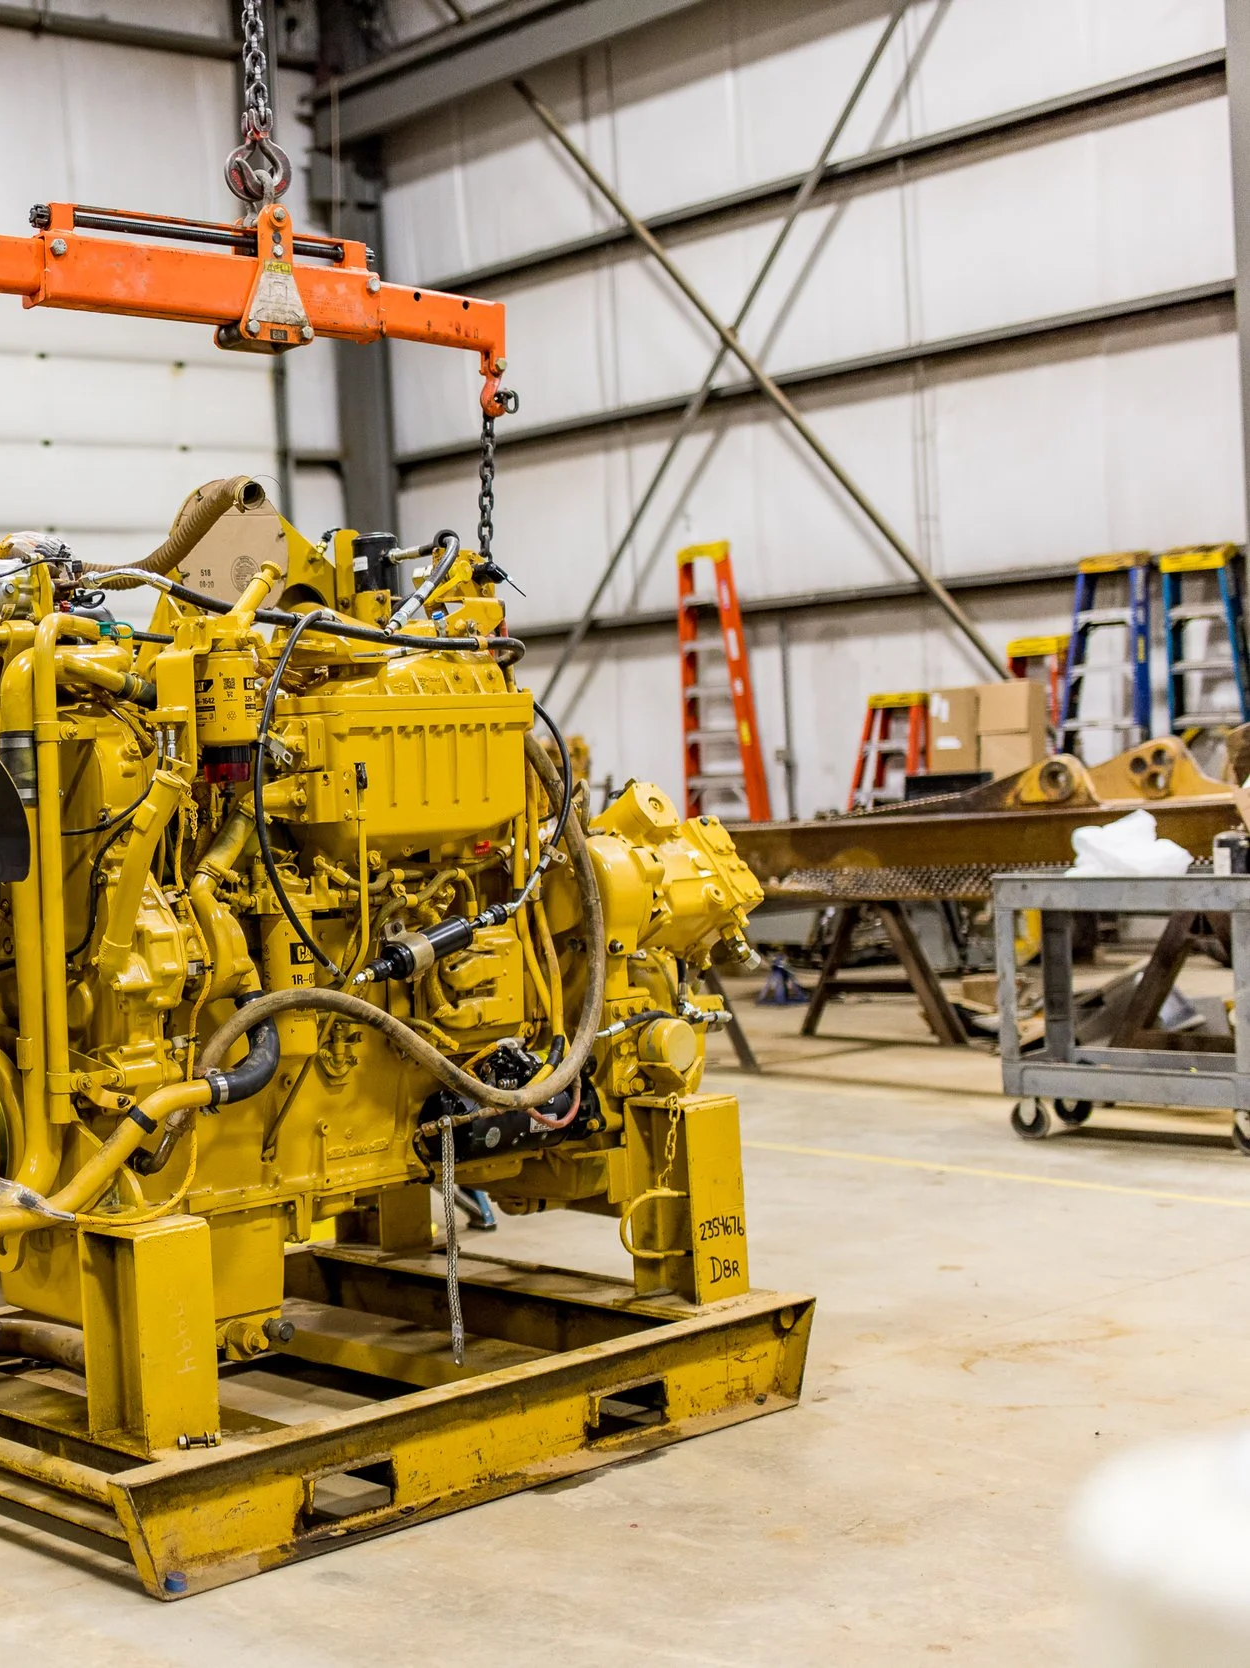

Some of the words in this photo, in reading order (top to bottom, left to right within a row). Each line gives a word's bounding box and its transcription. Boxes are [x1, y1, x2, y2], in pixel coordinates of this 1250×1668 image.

[297, 945, 314, 962] CA
[698, 1215, 745, 1241] 2354676
[709, 1256, 741, 1284] D8R
